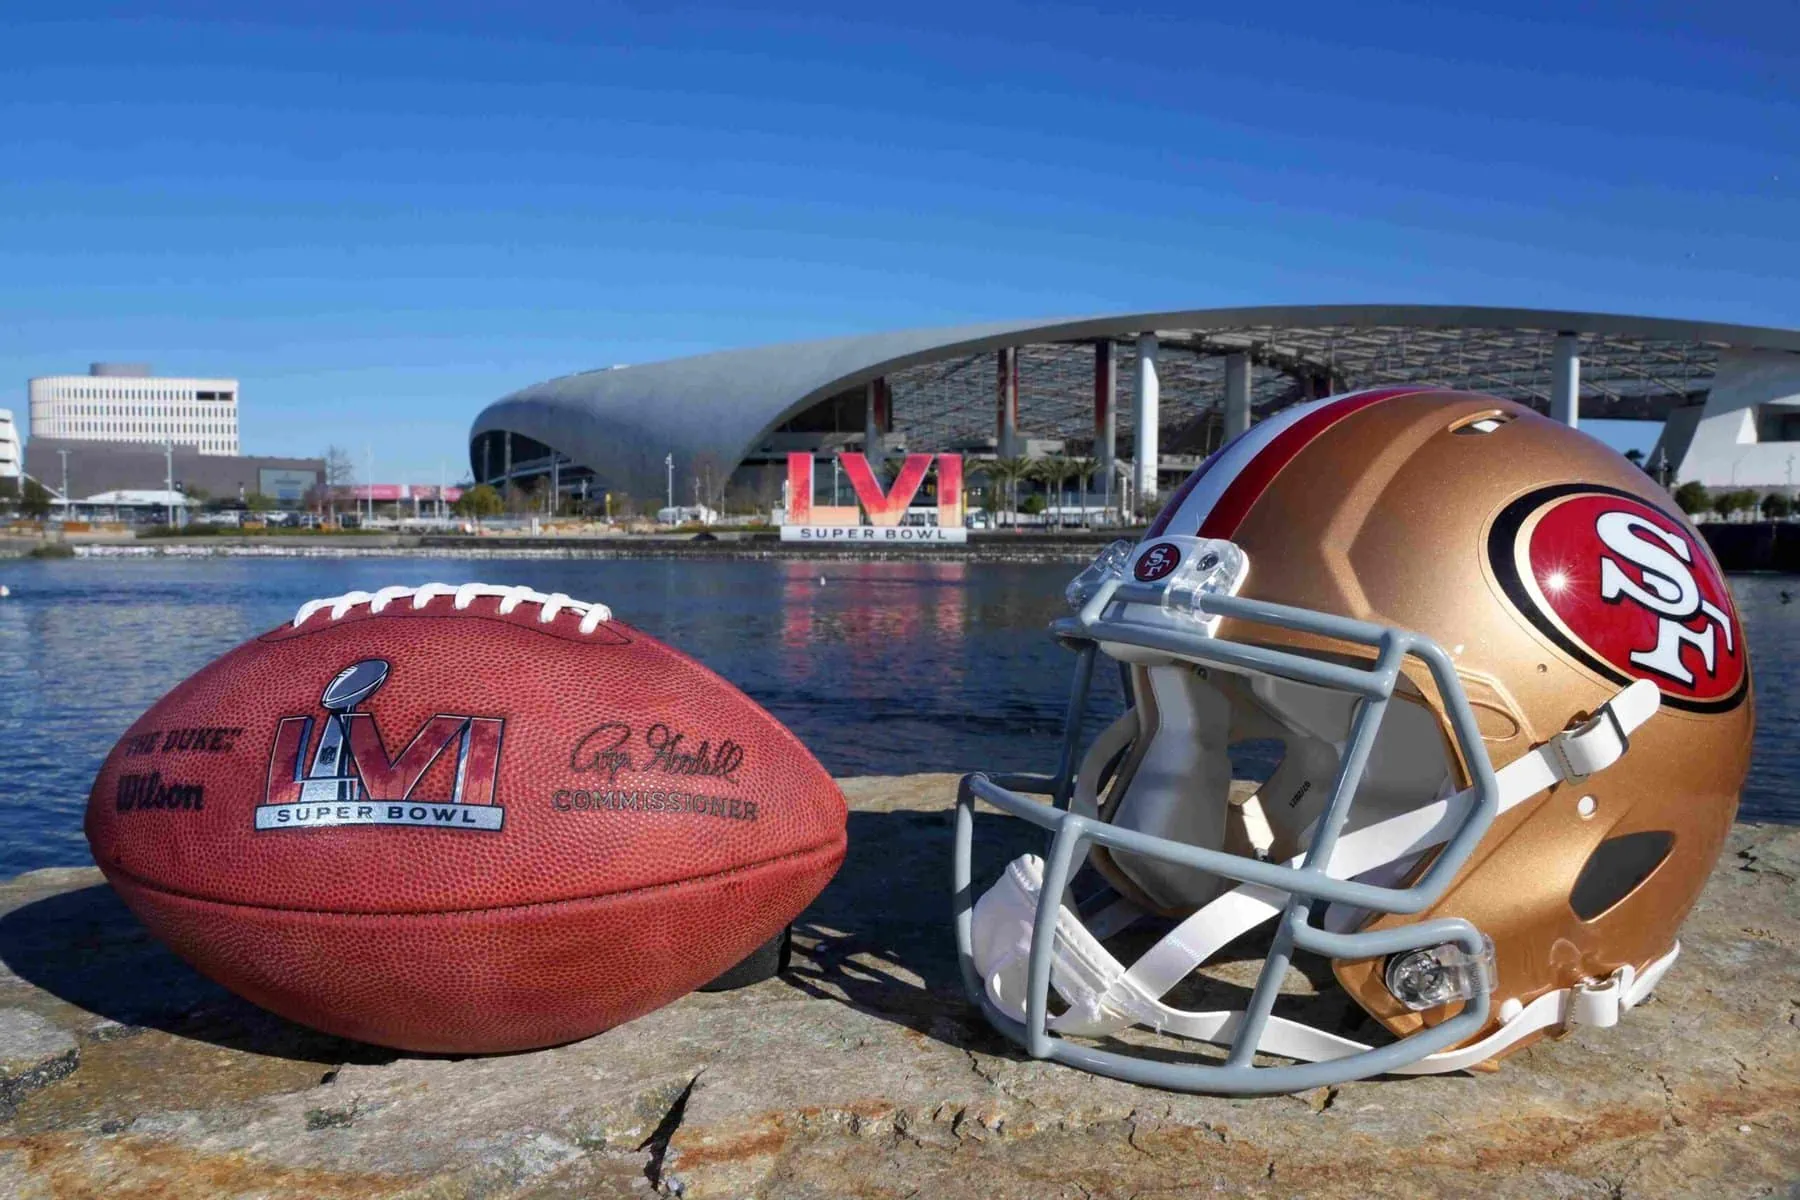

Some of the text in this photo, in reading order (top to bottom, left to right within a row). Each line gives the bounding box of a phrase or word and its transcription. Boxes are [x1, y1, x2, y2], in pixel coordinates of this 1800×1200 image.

[787, 452, 963, 526] LVI
[801, 528, 947, 540] SUPER BOWL
[265, 712, 505, 804] LVI
[117, 770, 205, 811] Wilson
[552, 789, 759, 821] COMMISSIONER
[277, 806, 477, 824] SUPER BOWL
